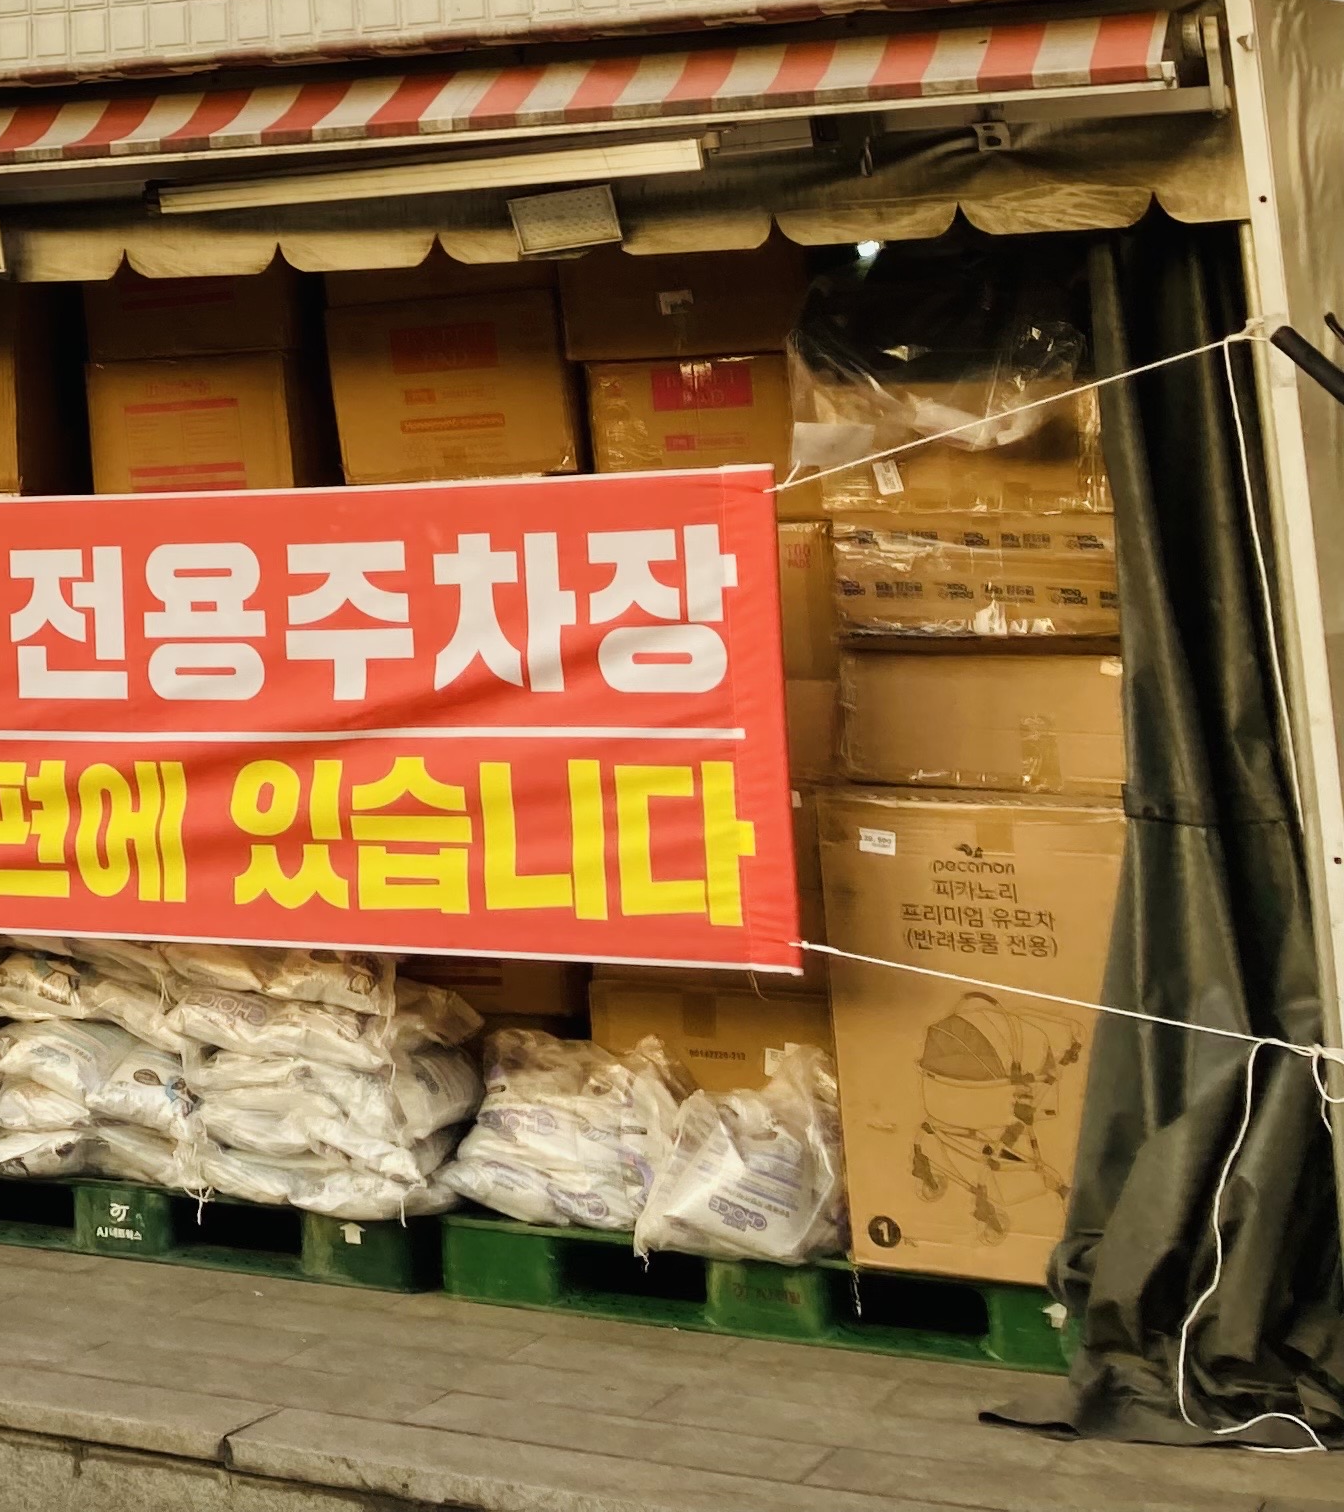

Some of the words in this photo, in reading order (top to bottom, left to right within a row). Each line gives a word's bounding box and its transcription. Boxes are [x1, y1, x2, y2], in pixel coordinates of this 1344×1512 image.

[6, 520, 739, 701] 전용주차장
[231, 754, 754, 927] 있습니다
[931, 879, 1019, 904] 피카노리
[901, 903, 985, 929] 프리미엄
[991, 907, 1056, 932] 유모차
[906, 927, 1000, 956] (반려동물
[1006, 933, 1059, 959] 전용)
